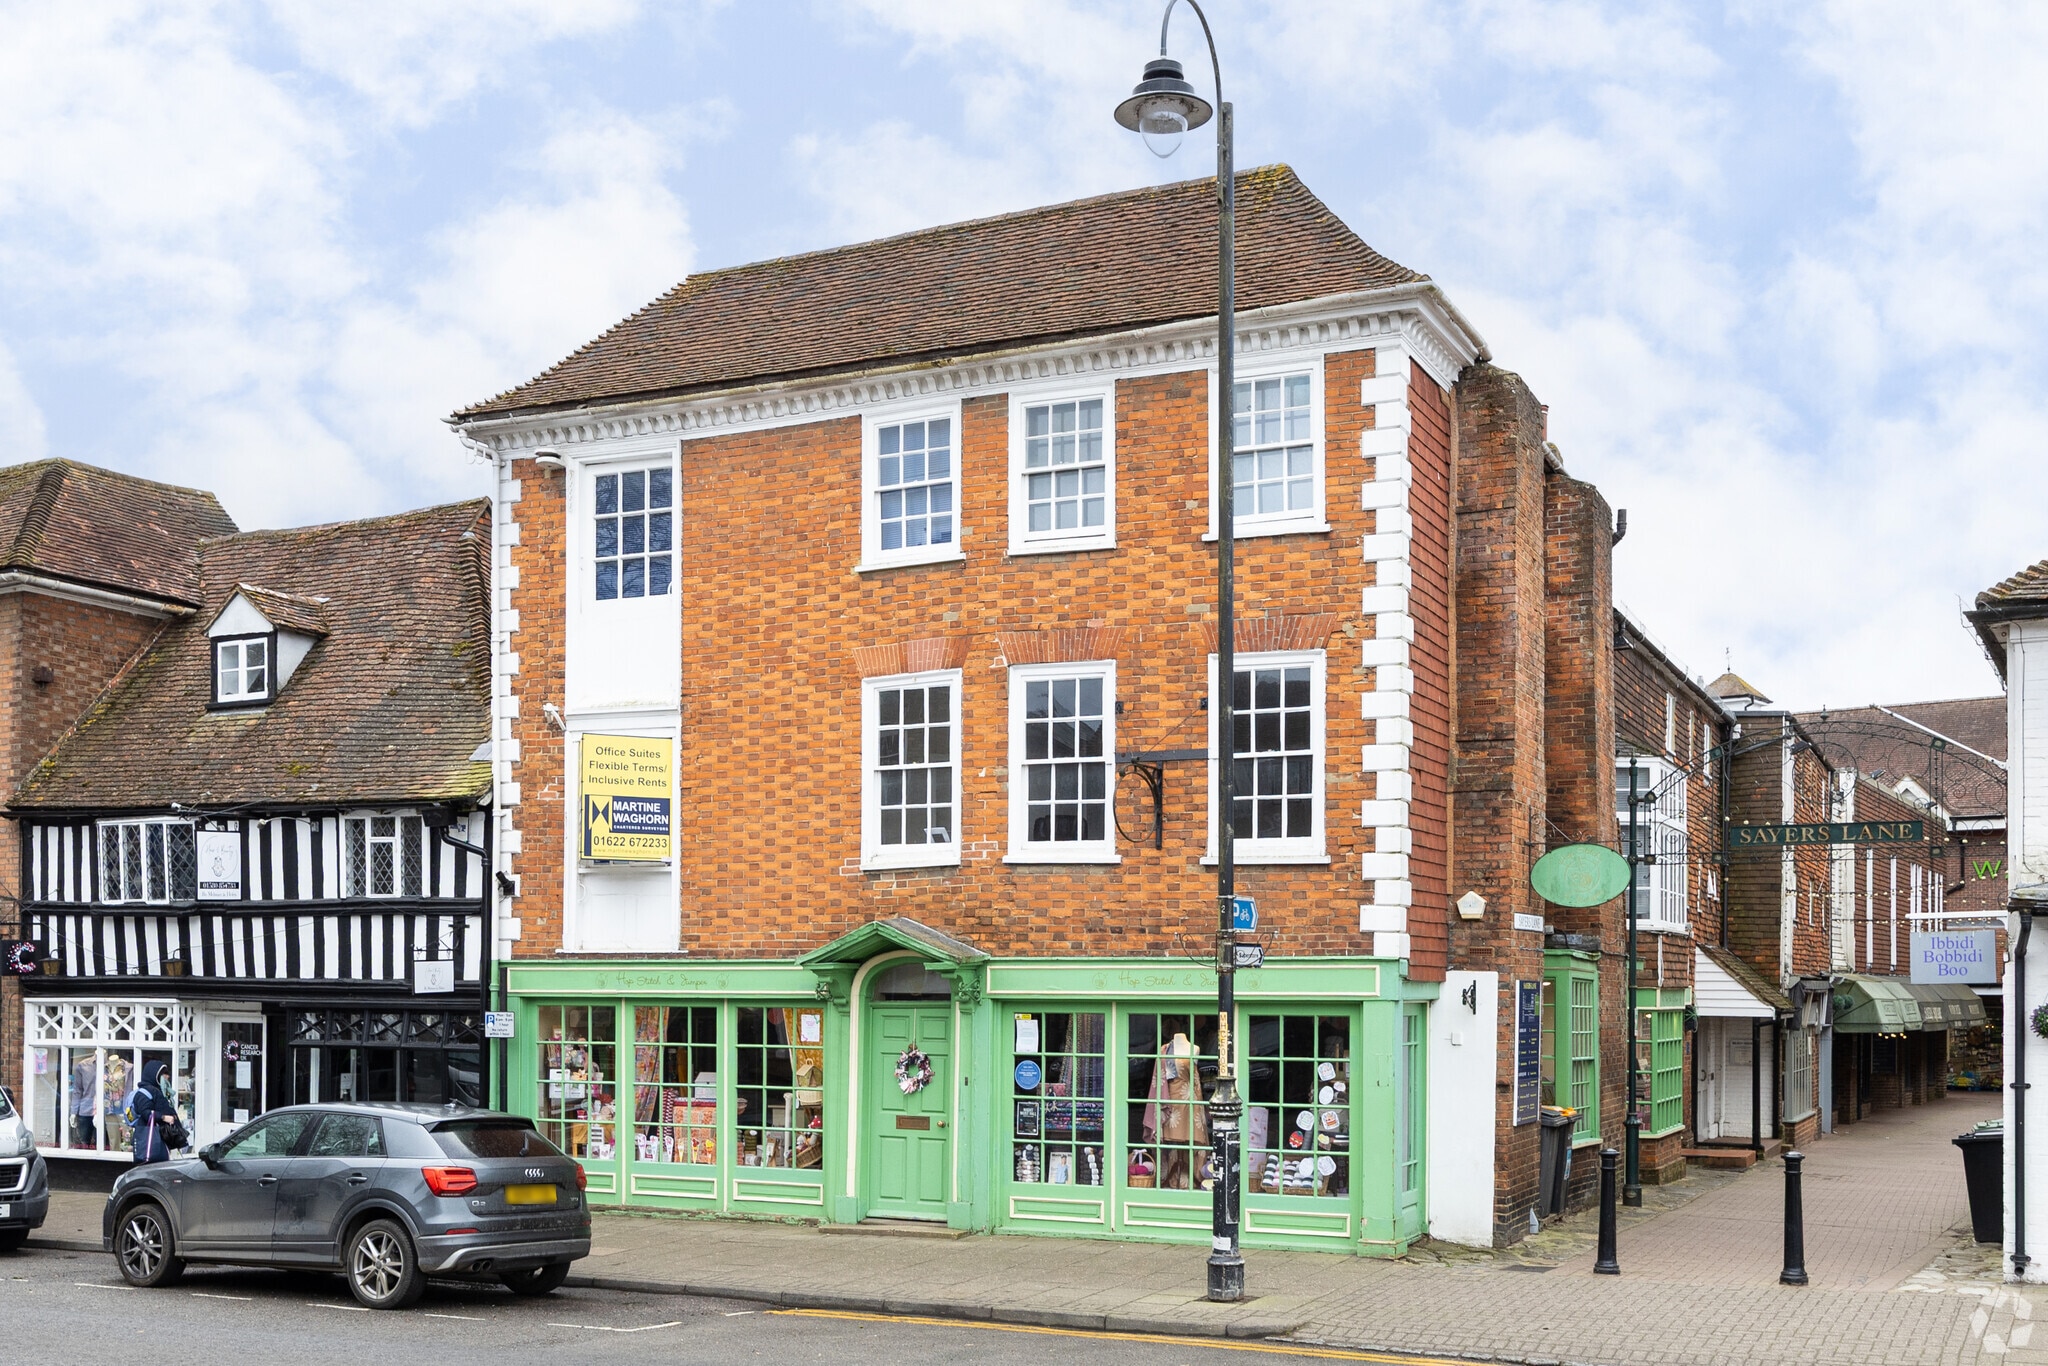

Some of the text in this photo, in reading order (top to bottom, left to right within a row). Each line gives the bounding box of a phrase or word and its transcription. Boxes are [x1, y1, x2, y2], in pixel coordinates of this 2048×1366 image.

[596, 746, 661, 758] Office Suites
[589, 760, 667, 773] Flexible Terms/
[588, 775, 667, 787] Inclusive Rents
[613, 801, 661, 812] MARTINE
[613, 813, 669, 824] WAGHORN
[1739, 823, 1913, 844] SAYERS LANE
[593, 836, 668, 848] 01622 672233
[1931, 935, 1974, 949] Ibbidi
[1923, 949, 1982, 963] Bobbidi
[1938, 964, 1968, 976] Boo
[616, 971, 708, 990] Hop Stitch & Jumper
[1119, 971, 1140, 988] Hop
[1144, 975, 1175, 986] Stitch
[1183, 974, 1193, 986] &
